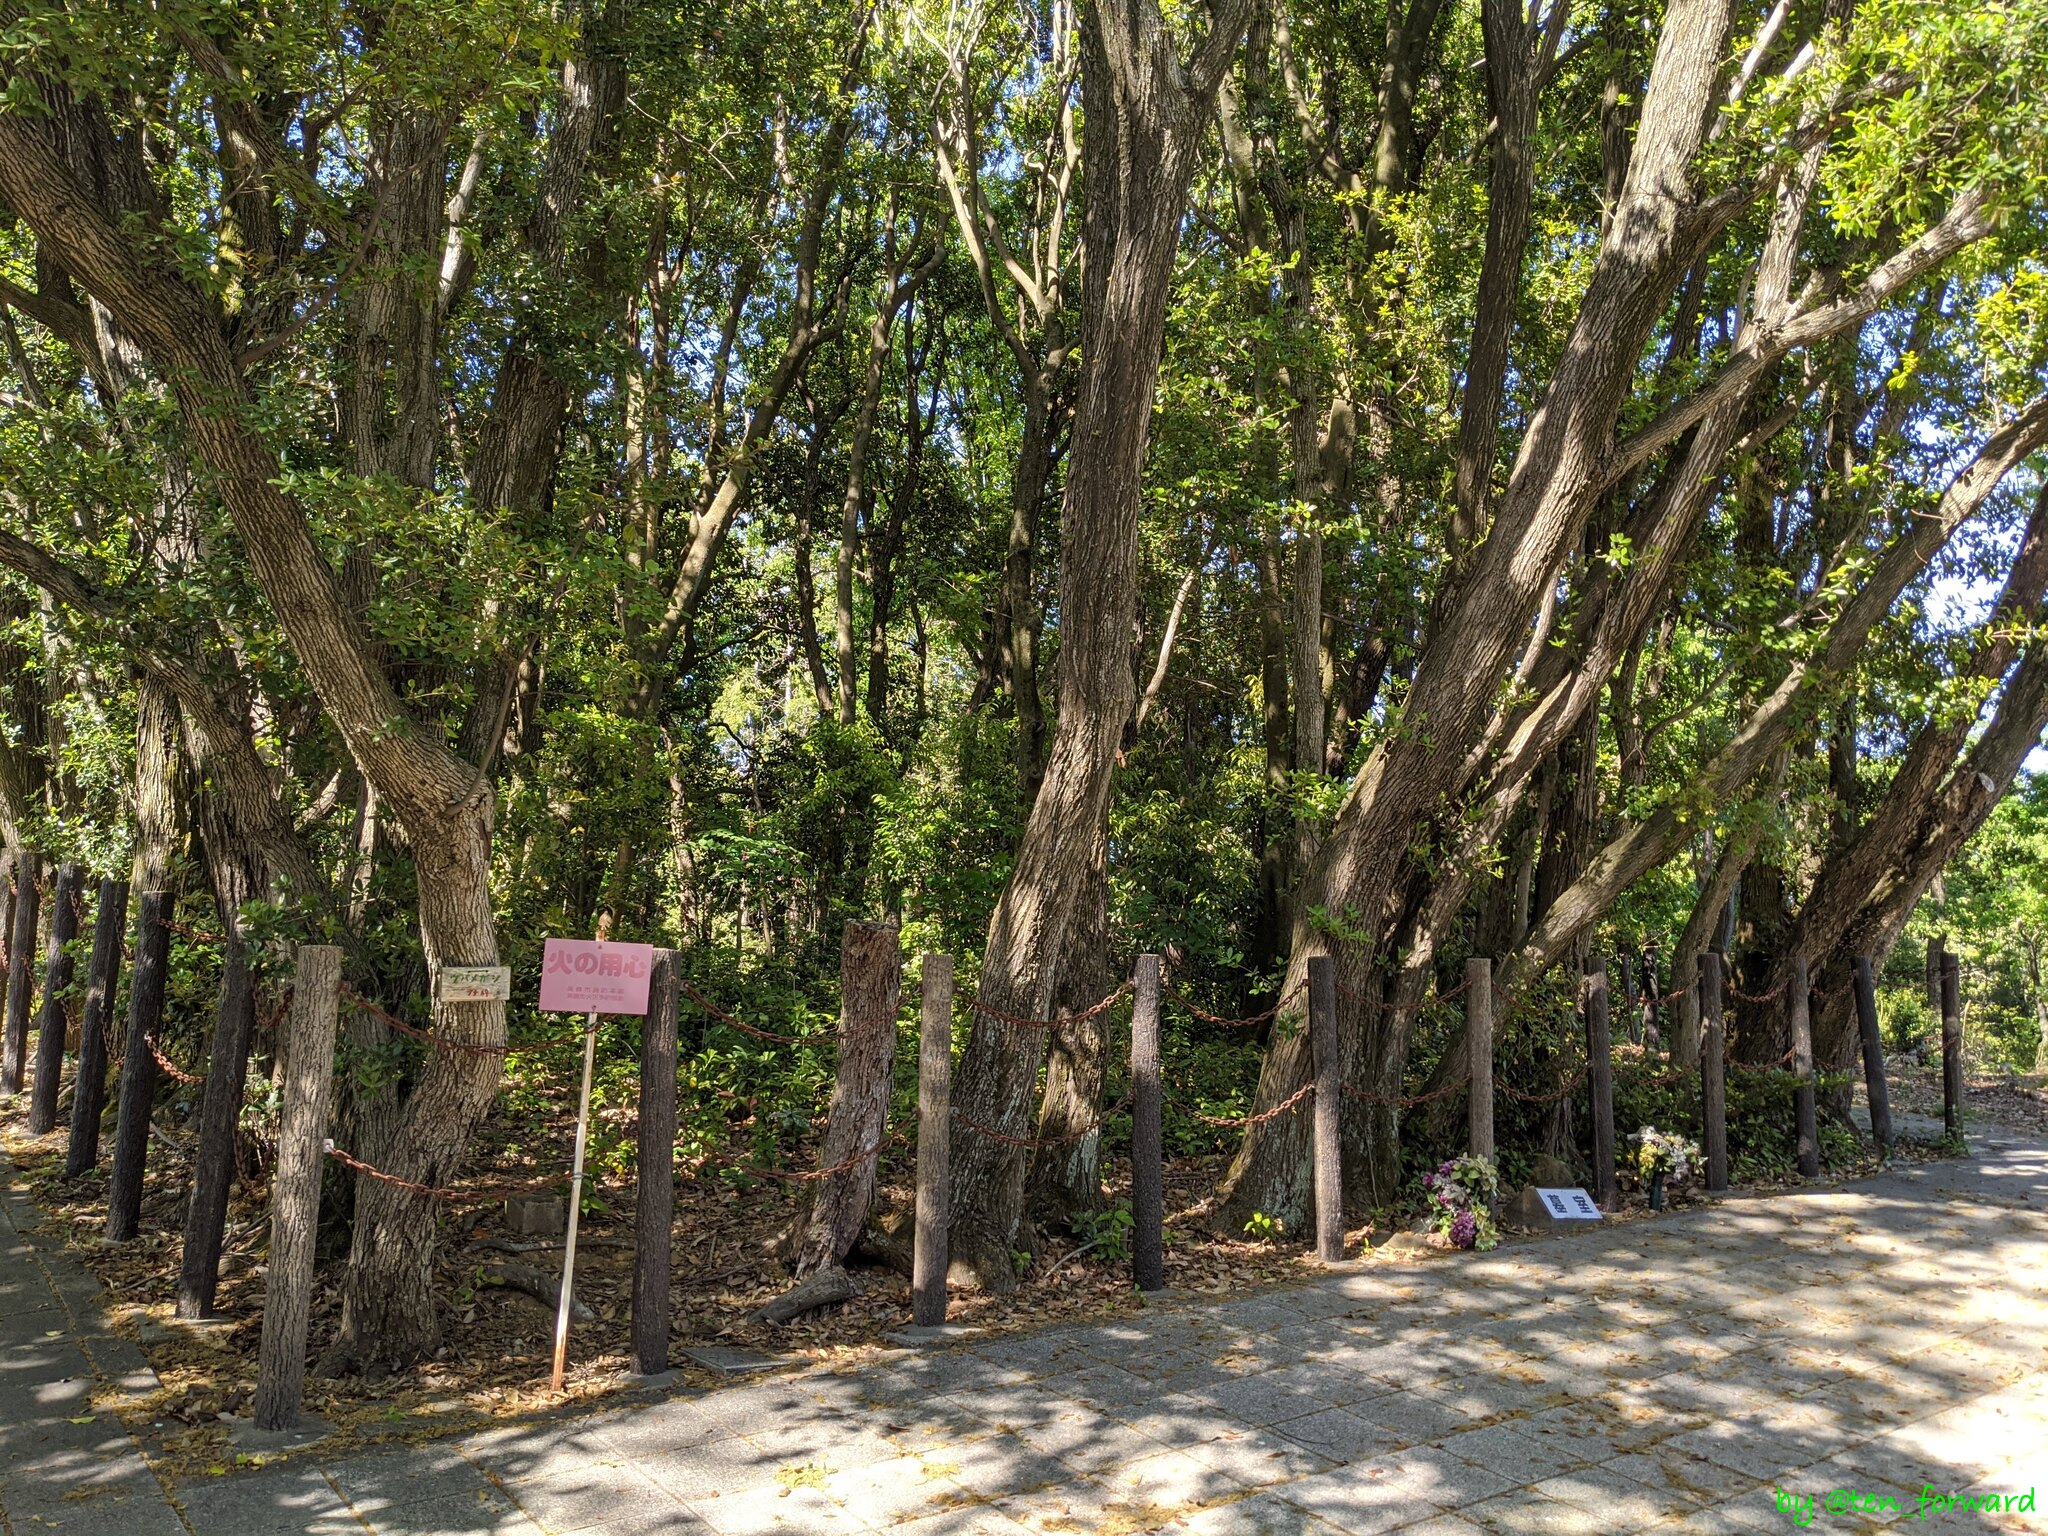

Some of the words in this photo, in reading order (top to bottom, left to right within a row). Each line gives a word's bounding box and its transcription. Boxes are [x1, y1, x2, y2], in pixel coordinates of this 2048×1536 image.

[547, 950, 647, 979] 火の用心
[1546, 1194, 1594, 1214] 墓室
